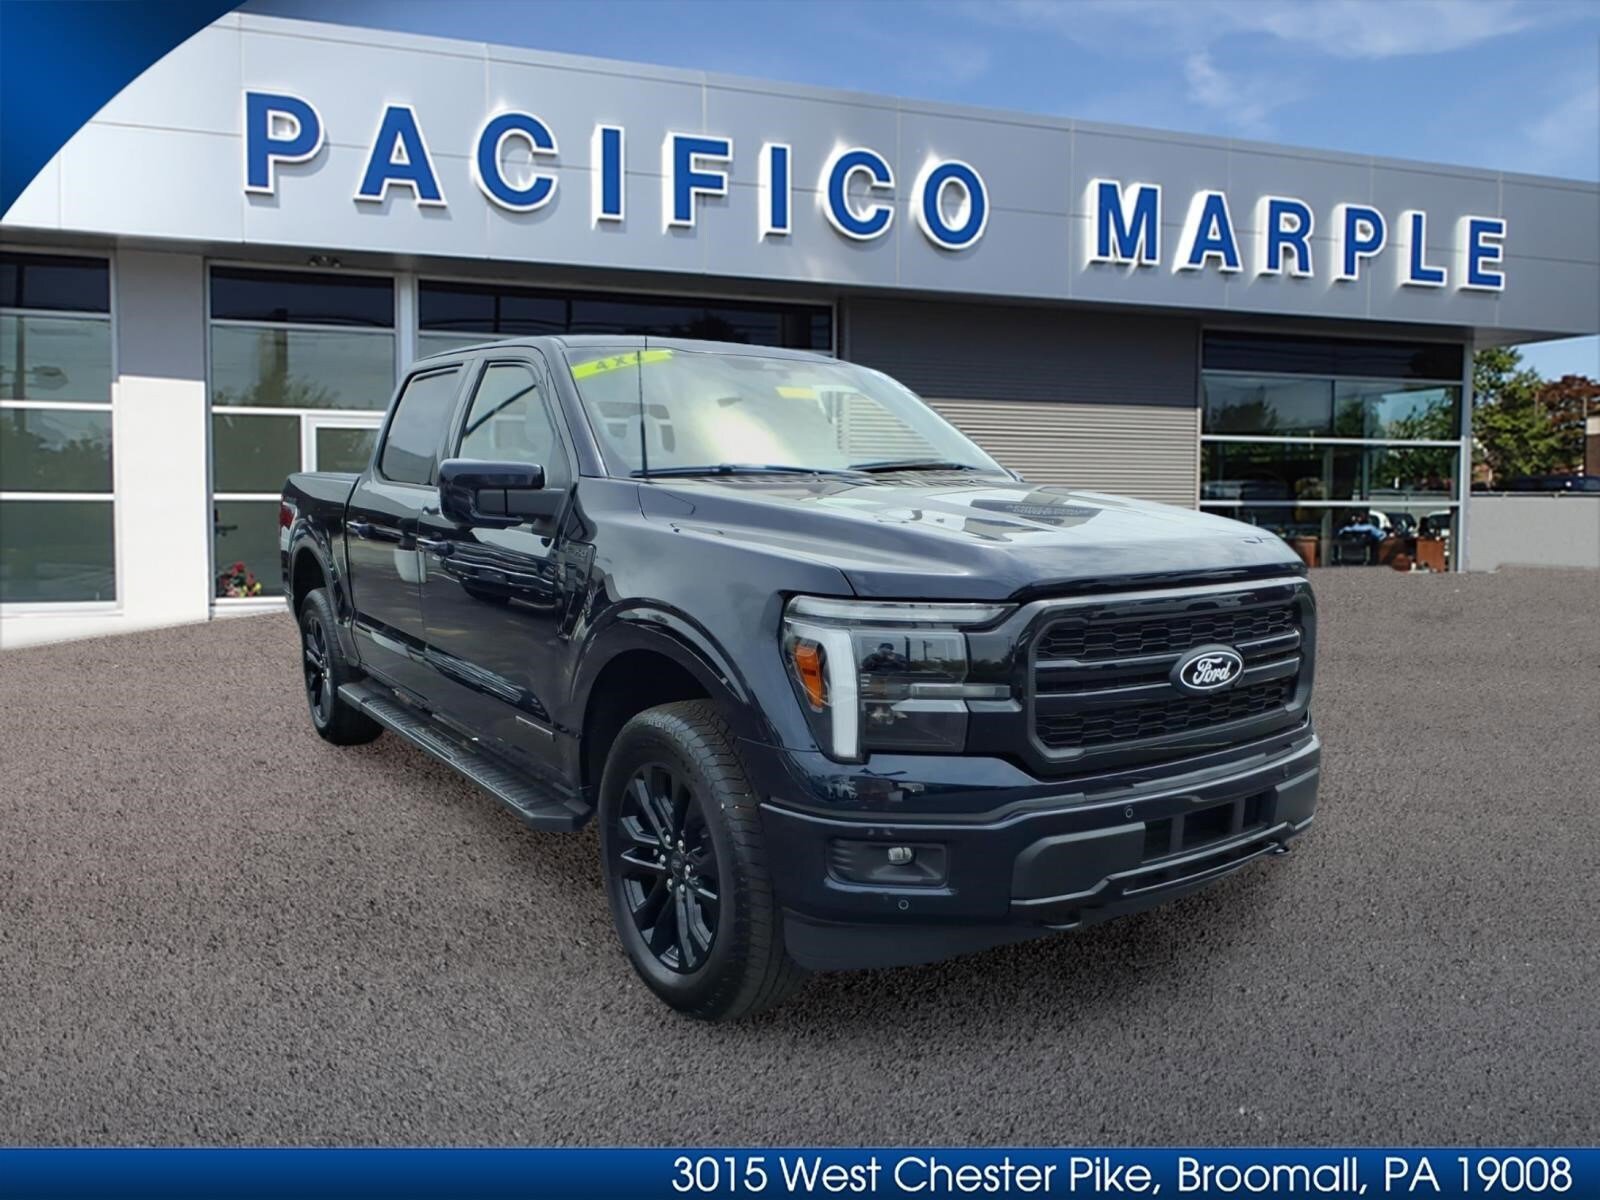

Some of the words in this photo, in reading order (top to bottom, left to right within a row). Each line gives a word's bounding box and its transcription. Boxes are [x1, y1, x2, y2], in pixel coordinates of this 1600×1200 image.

[244, 89, 989, 249] PACIFICO
[1090, 179, 1506, 291] MARPLE
[1192, 657, 1232, 685] Ford
